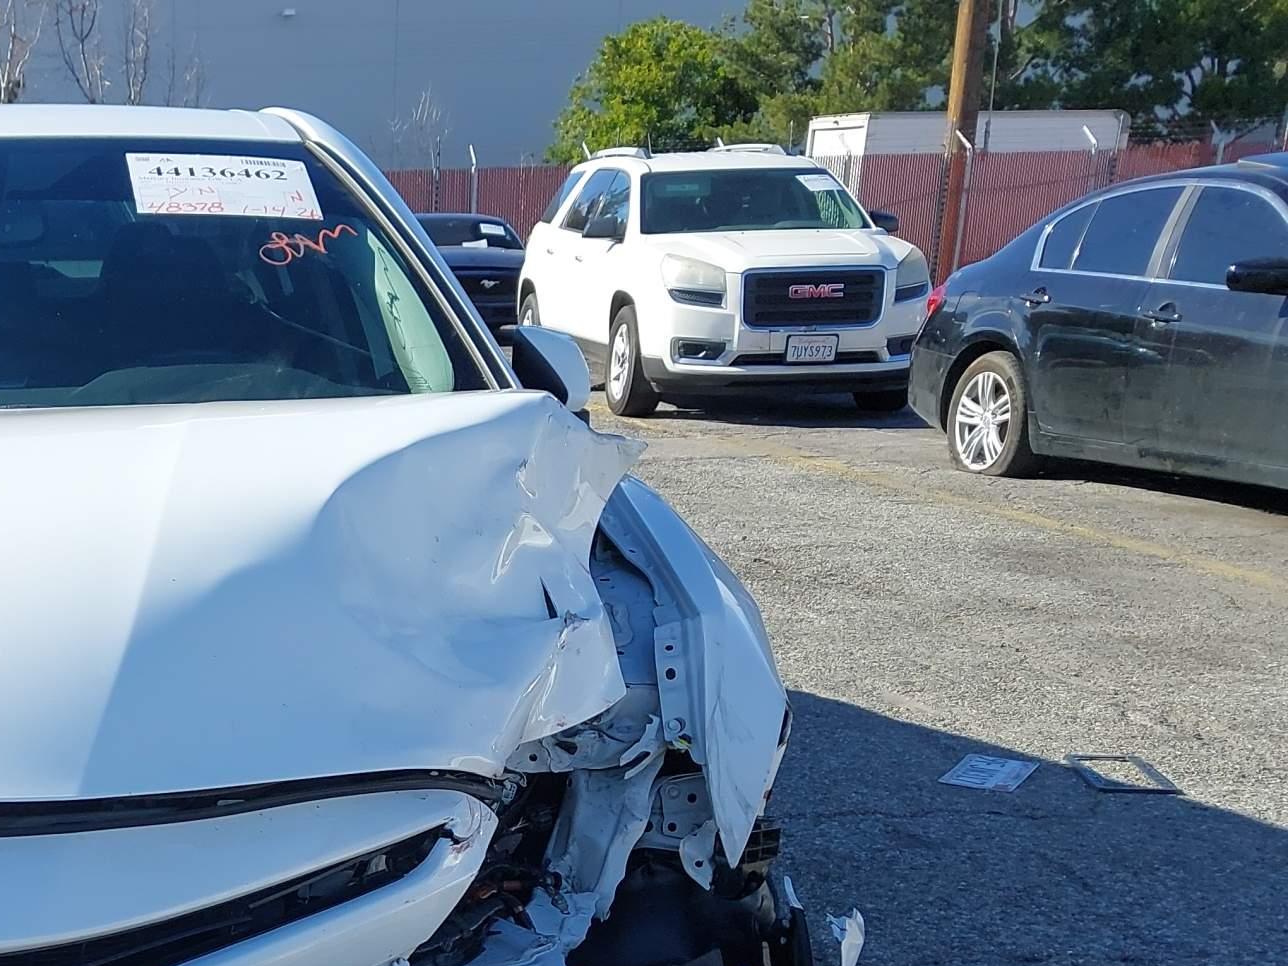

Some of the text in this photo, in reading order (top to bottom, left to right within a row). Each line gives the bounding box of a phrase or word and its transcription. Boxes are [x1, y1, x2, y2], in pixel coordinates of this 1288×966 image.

[149, 166, 288, 181] 44136462
[788, 283, 845, 298] GMC
[791, 345, 833, 358] 7UYS973
